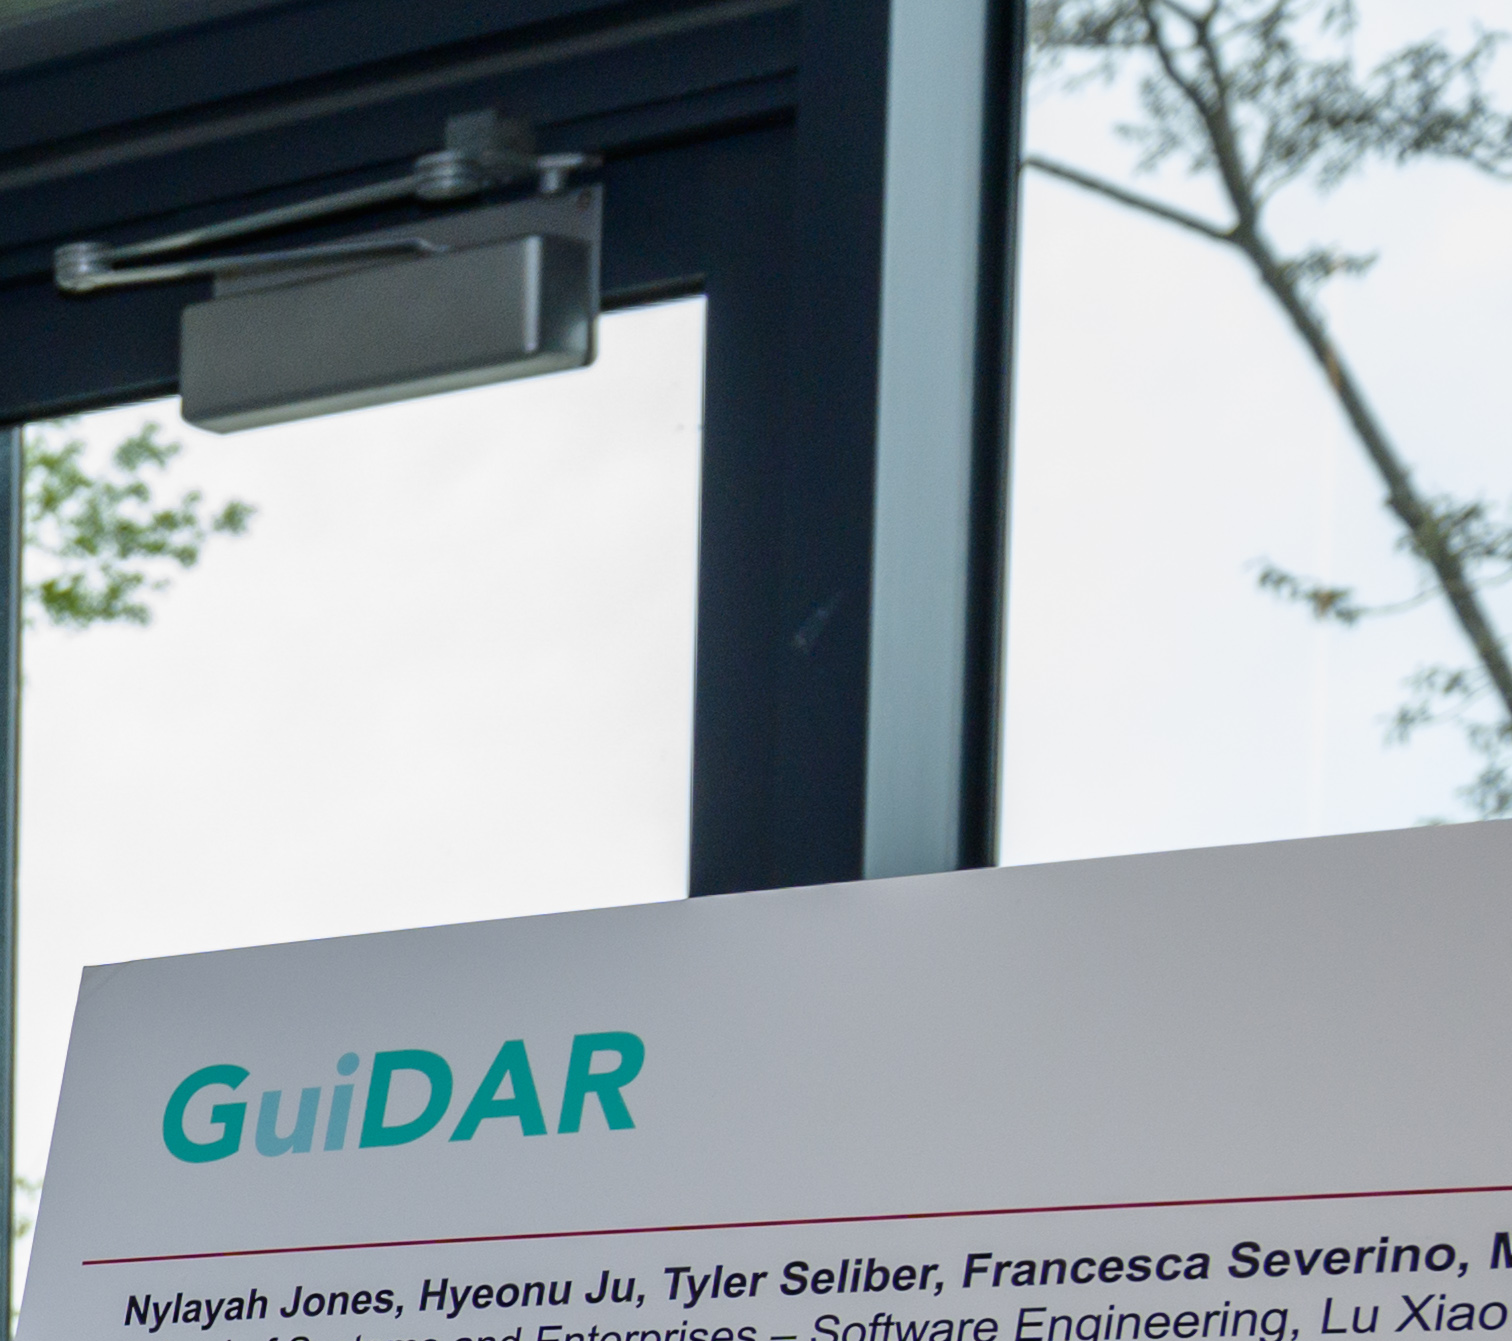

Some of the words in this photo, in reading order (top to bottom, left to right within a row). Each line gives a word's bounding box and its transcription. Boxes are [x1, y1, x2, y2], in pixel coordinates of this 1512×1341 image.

[162, 1030, 646, 1164] GuiDAR
[123, 1287, 268, 1334] Nylayah
[279, 1284, 404, 1320] Jones,
[418, 1277, 572, 1320] Hyeonu
[584, 1269, 645, 1309] Ju,
[663, 1264, 769, 1309] Tyler
[779, 1256, 944, 1297] Seliber,
[961, 1251, 1211, 1288] Francesca
[1227, 1235, 1469, 1279] Severino,
[1320, 1296, 1379, 1335] Lu
[1394, 1293, 1508, 1333] Xiao
